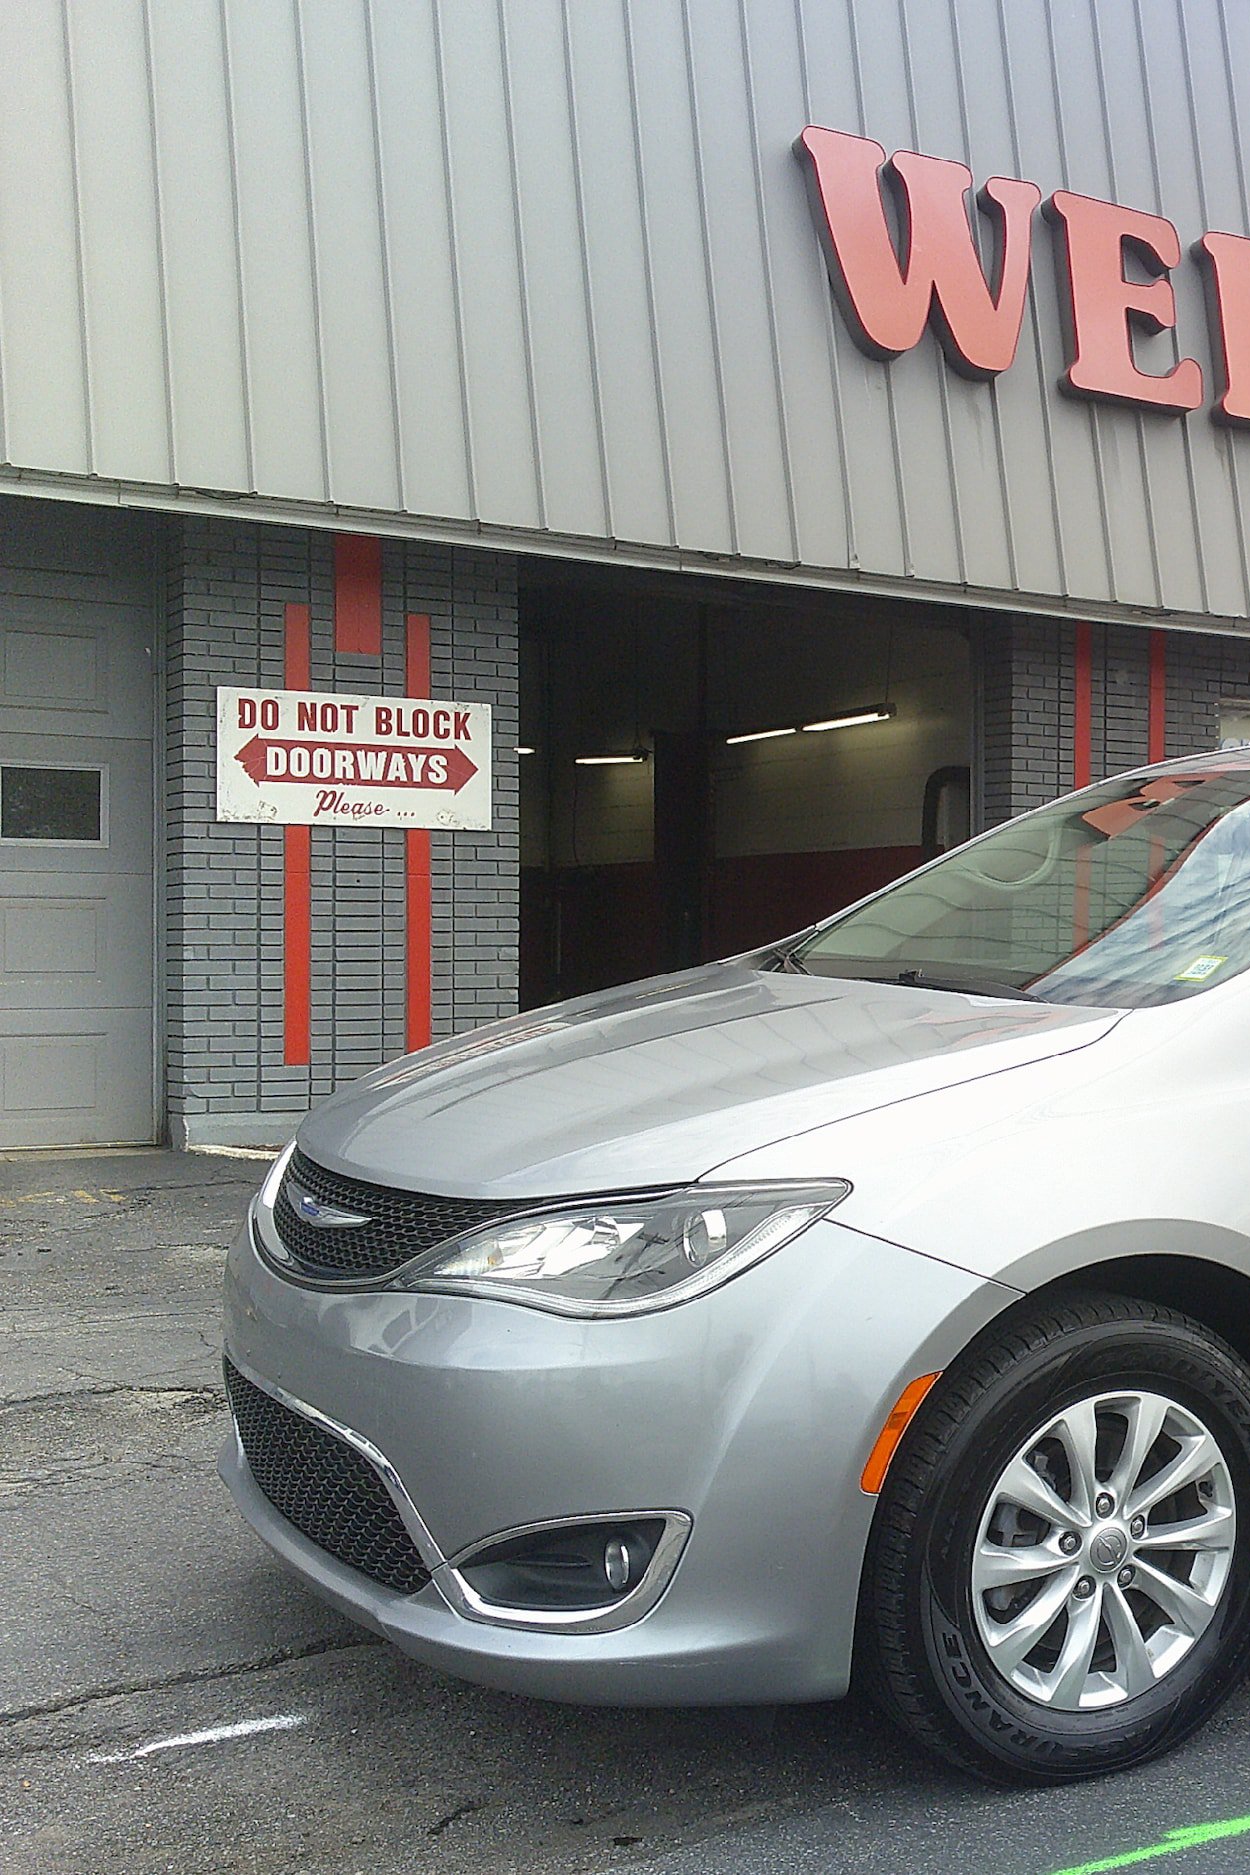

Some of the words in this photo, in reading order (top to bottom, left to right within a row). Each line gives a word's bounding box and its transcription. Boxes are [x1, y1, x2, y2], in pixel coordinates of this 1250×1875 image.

[238, 698, 279, 731] DO
[297, 702, 359, 735] NOT
[375, 706, 472, 741] BLOCK
[266, 746, 449, 784] DOORWAYS
[313, 789, 390, 818] Please
